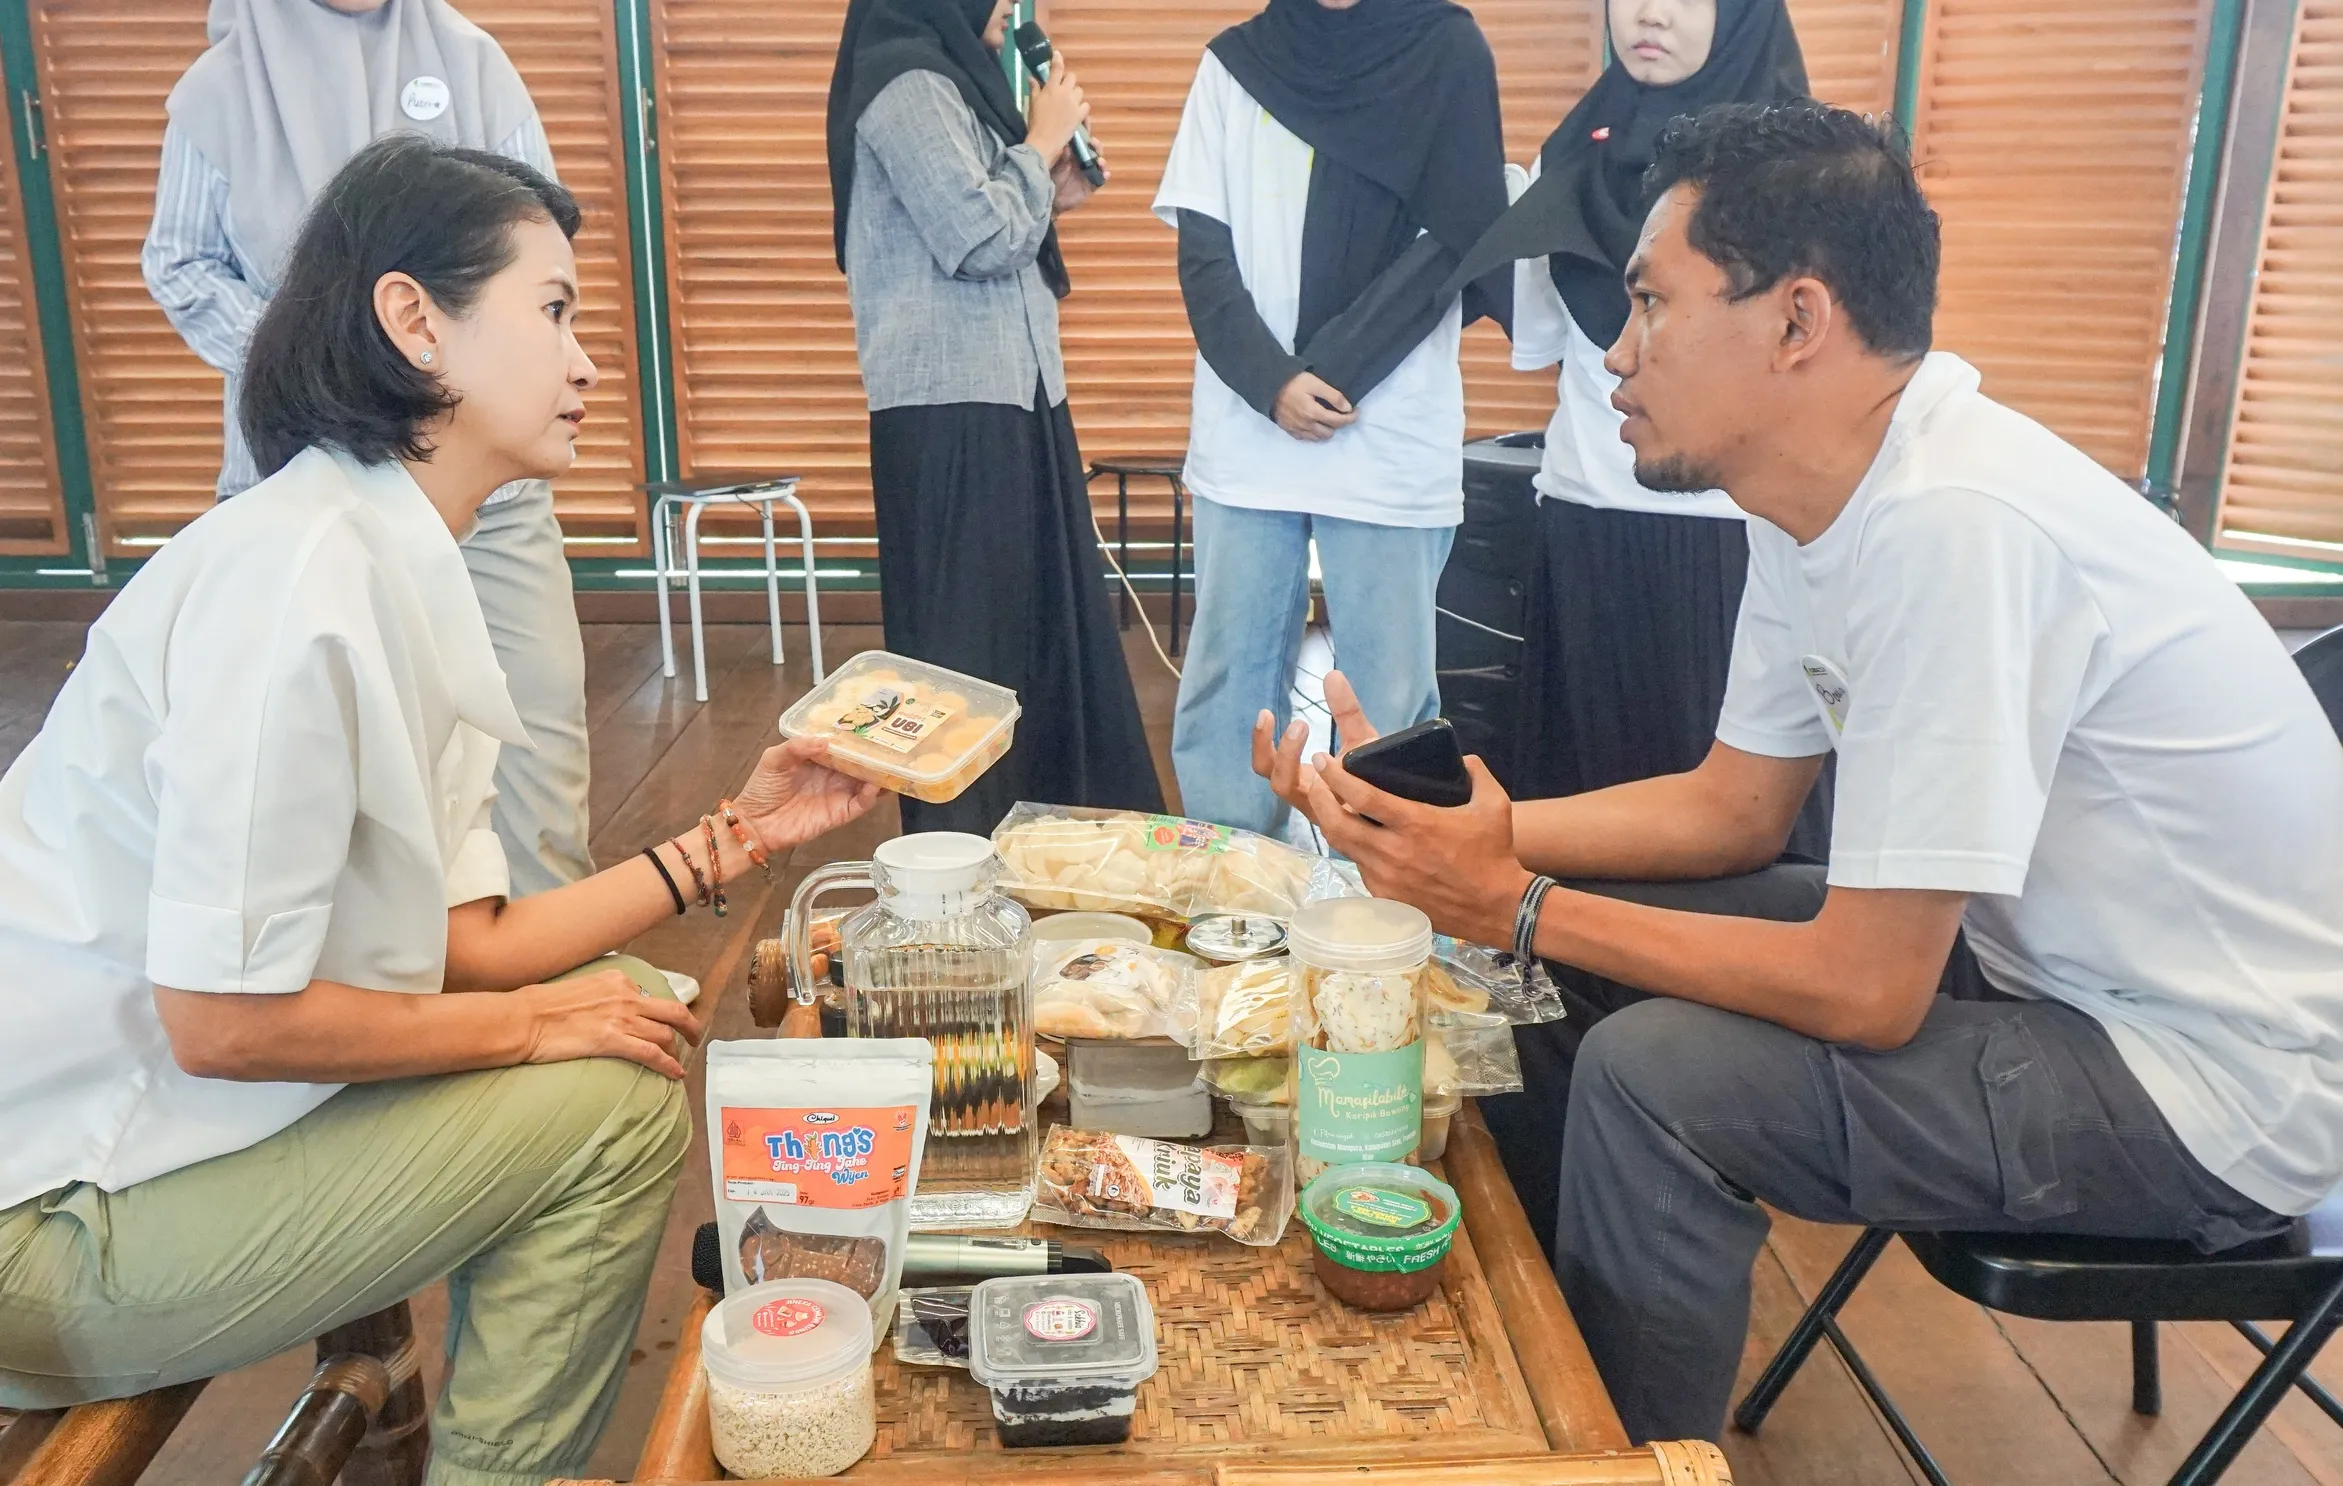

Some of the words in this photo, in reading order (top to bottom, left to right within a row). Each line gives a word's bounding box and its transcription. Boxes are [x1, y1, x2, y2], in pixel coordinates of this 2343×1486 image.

[891, 717, 924, 734] UBI
[831, 1169, 869, 1185] Wijen
[1178, 1147, 1201, 1205] apaya
[799, 1195, 809, 1203] 97
[1403, 1246, 1440, 1264] FRESH
